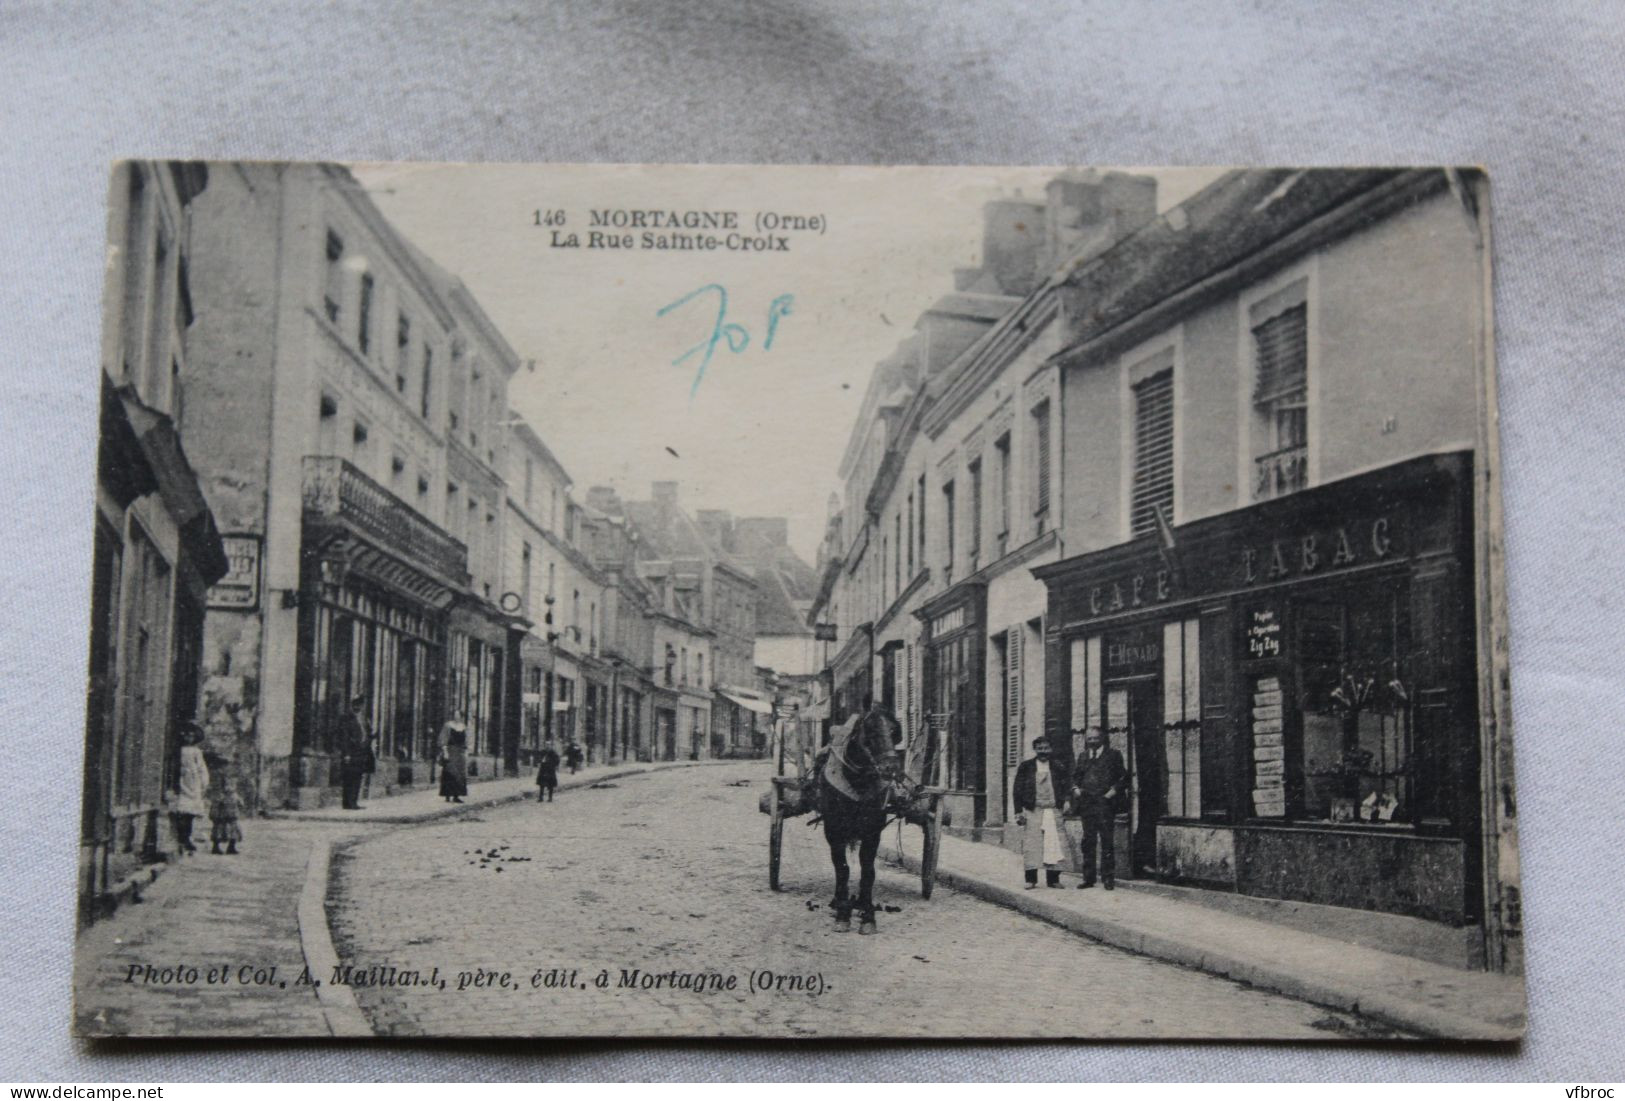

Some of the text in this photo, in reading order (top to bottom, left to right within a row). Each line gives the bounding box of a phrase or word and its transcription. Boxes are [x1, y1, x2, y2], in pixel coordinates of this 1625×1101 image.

[532, 209, 827, 234] 146 MORTAGNE (Orne)
[550, 230, 790, 251] La Rue Sainte-Croix
[1242, 517, 1392, 584] TABAC
[1250, 636, 1279, 657] Zig Zag
[123, 963, 200, 985] Photo
[206, 964, 230, 985] et
[236, 965, 287, 989] Col.
[294, 967, 322, 988] A.
[456, 967, 521, 991] père,
[530, 968, 588, 991] édit.
[594, 969, 609, 988] à
[616, 969, 738, 991] Mortagne
[749, 969, 834, 995] (Orne).
